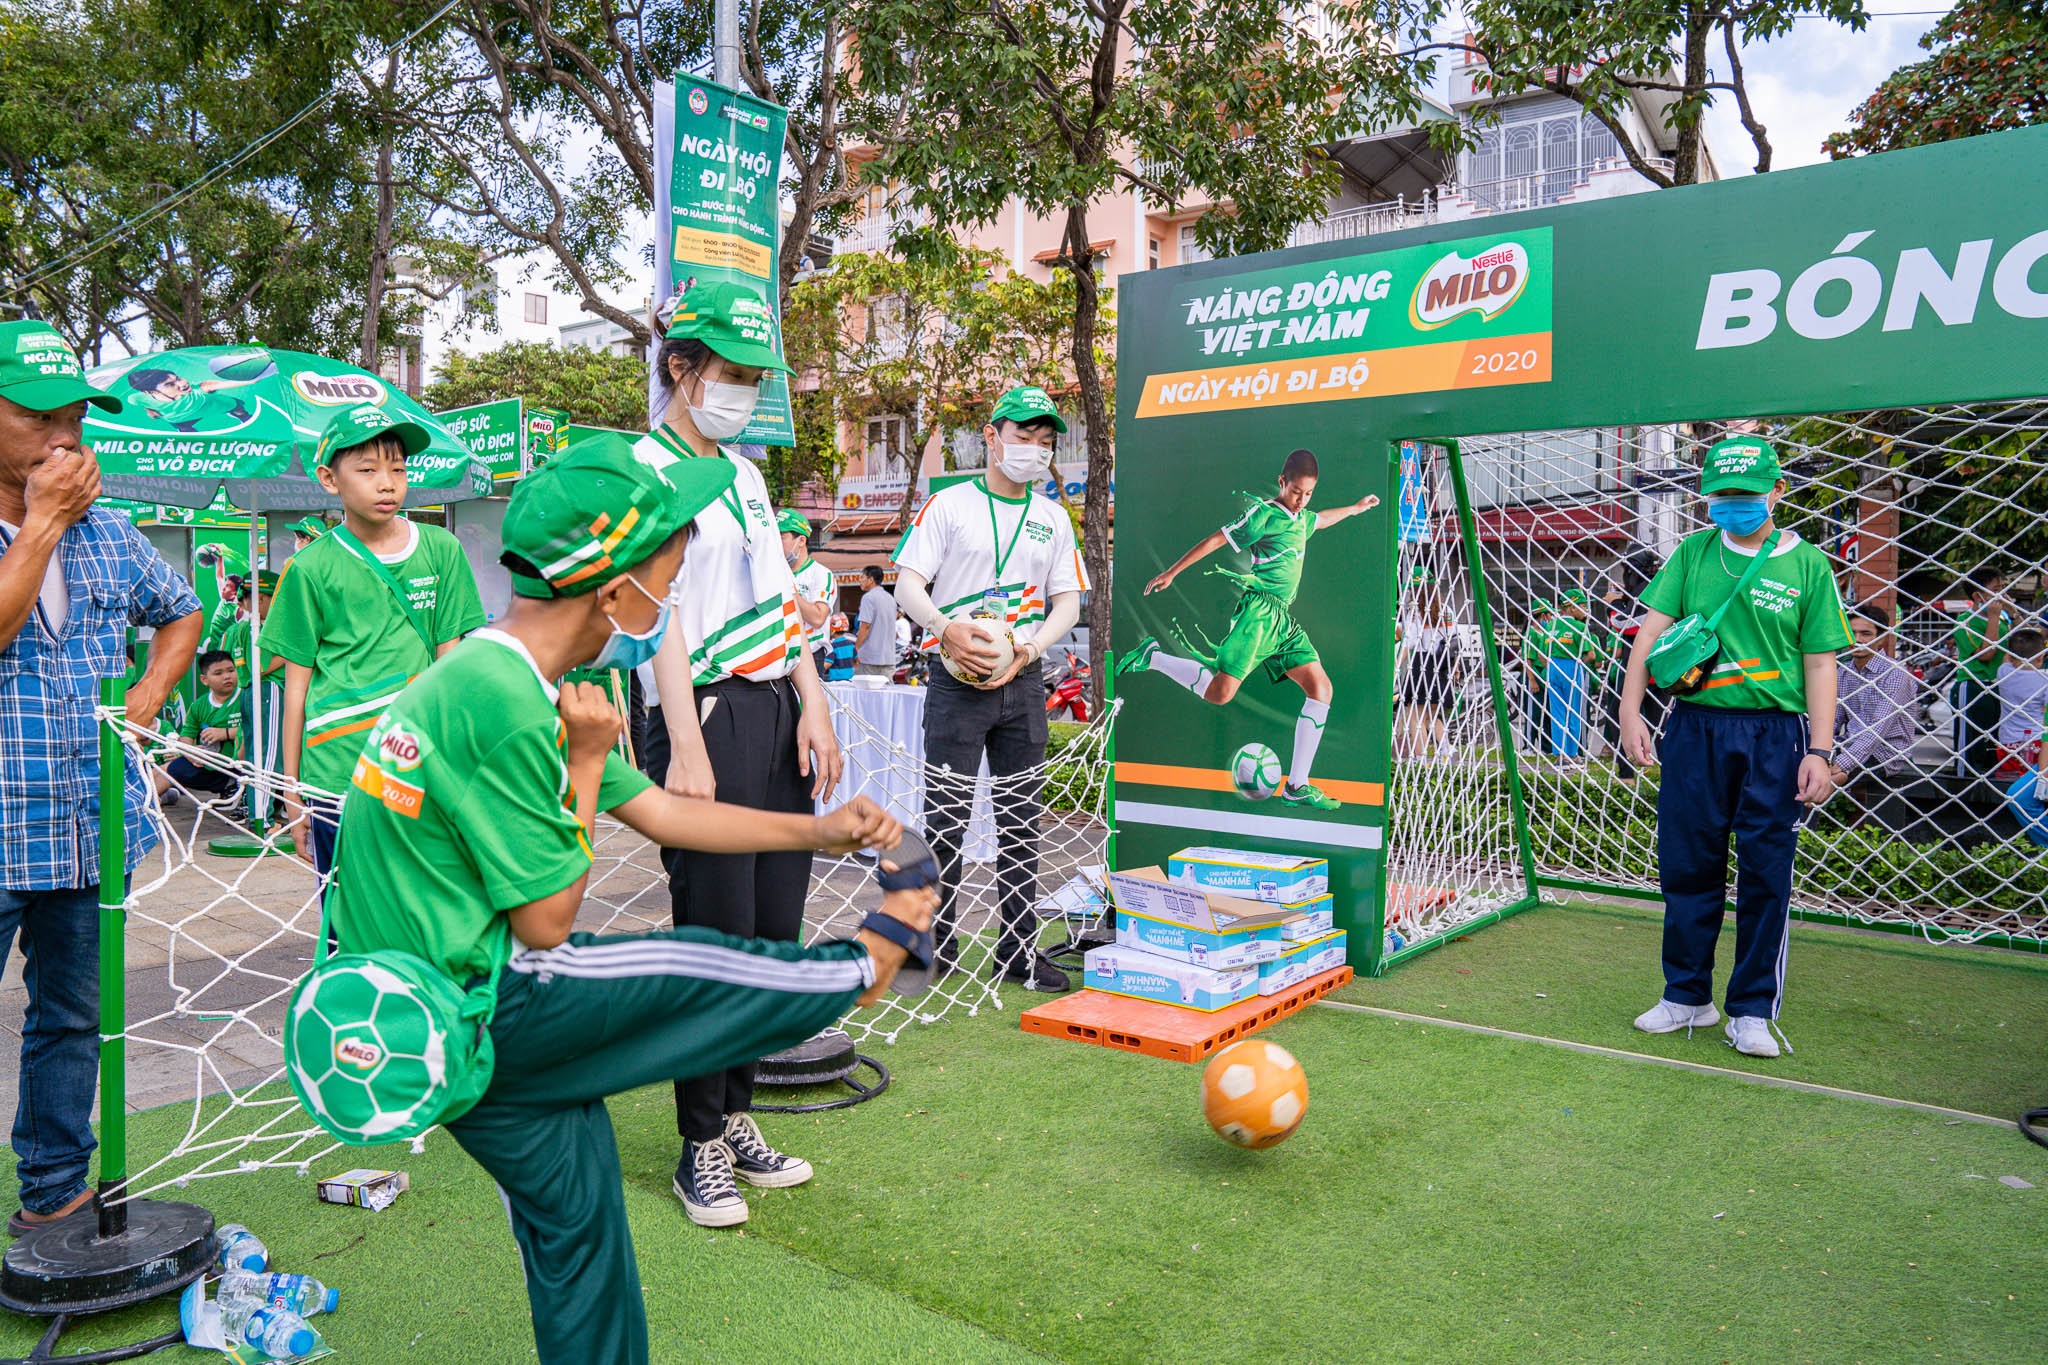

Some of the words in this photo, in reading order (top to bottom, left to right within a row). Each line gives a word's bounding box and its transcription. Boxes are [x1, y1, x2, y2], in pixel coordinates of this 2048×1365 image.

[680, 133, 739, 163] NGÀY
[739, 150, 772, 179] HỘI
[699, 168, 726, 191] ĐI
[672, 205, 689, 216] CHO
[1471, 249, 1514, 271] Nestlé
[1181, 286, 1283, 325] NĂNG
[1281, 270, 1393, 314] ĐỘNG
[1425, 264, 1517, 312] MILO
[1194, 317, 1282, 358] VIỆT
[1272, 307, 1371, 347] NAM
[23, 349, 63, 364] NGÀY
[1471, 349, 1538, 375] 2020
[39, 364, 57, 375] ĐI
[302, 379, 378, 398] MILO
[1158, 374, 1228, 405] NGÀY
[1227, 368, 1280, 401] HỘI
[1286, 368, 1318, 392] ĐI
[1320, 357, 1369, 392] BỘ
[469, 412, 491, 433] SỨC
[532, 421, 552, 432] MILO
[92, 440, 145, 455] MILO
[146, 438, 205, 455] NĂNG
[208, 441, 278, 461] LƯỢNG
[470, 436, 485, 453] VÔ
[487, 432, 515, 453] ĐỊCH
[157, 455, 185, 472] VÔ
[188, 458, 237, 474] ĐỊCH
[405, 454, 457, 471] LƯỢNG
[499, 451, 514, 462] CON
[1714, 456, 1739, 467] NGÀY
[863, 490, 923, 507] EMPERR
[1750, 588, 1777, 601] NGÀY
[1754, 598, 1766, 608] ĐI
[381, 734, 420, 761] MILO
[382, 784, 416, 808] 2020
[342, 1044, 375, 1062] MILO
